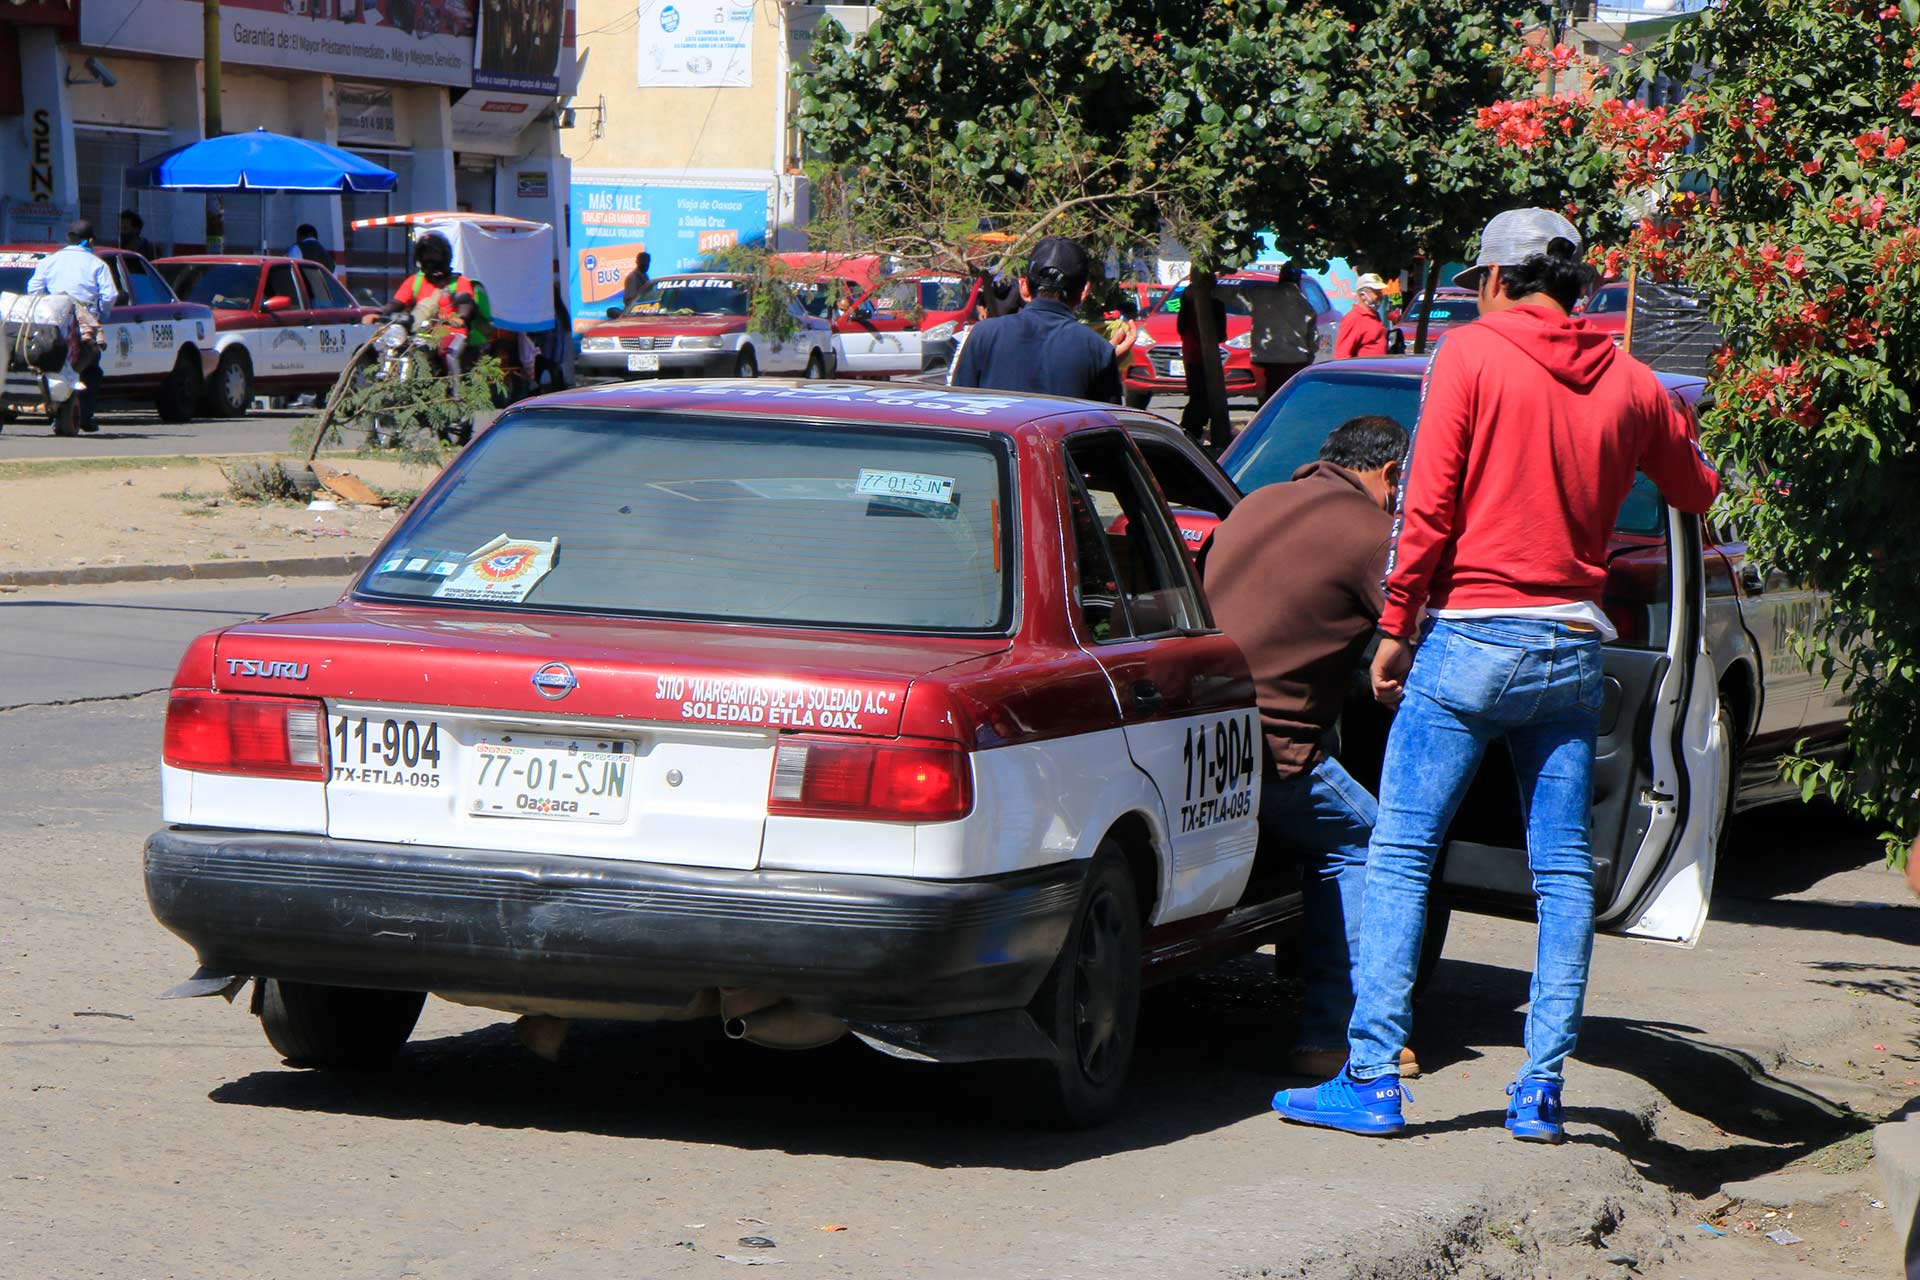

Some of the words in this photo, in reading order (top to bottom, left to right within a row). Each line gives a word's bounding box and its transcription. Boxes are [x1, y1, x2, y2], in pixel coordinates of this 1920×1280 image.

[233, 22, 274, 47] Garantía
[300, 36, 320, 56] Mayor
[321, 37, 352, 57] Préstamo
[352, 43, 385, 60] Inmediato
[391, 47, 404, 62] Más
[434, 51, 462, 69] Servicios
[589, 190, 613, 210] MÁS
[615, 194, 642, 211] VALE
[677, 199, 699, 212] Viaja
[700, 200, 711, 210] de
[712, 200, 742, 211] Oaxaca
[685, 215, 706, 227] Salina
[708, 216, 725, 228] Cruz
[598, 269, 620, 284] BU$
[657, 280, 687, 289] VILLA
[688, 279, 703, 288] DE
[705, 279, 733, 289] ETLA
[863, 474, 942, 494] 77-01-SJN
[226, 658, 309, 681] TSURU
[655, 676, 684, 701] SITIO
[771, 686, 786, 708] DE
[788, 685, 804, 709] LA
[807, 686, 862, 713] SOLEDAD
[681, 701, 764, 722] SOLEDAD
[768, 707, 815, 727] ETLA
[820, 710, 863, 730] OAX.
[335, 716, 440, 769] 11-904
[1184, 714, 1254, 801] 11-904
[334, 767, 440, 788] TX-ETLA-095
[478, 753, 626, 798] 77-01-SJN
[516, 793, 578, 813] Oaxaca
[1181, 790, 1251, 832] TX-ETLA-095
